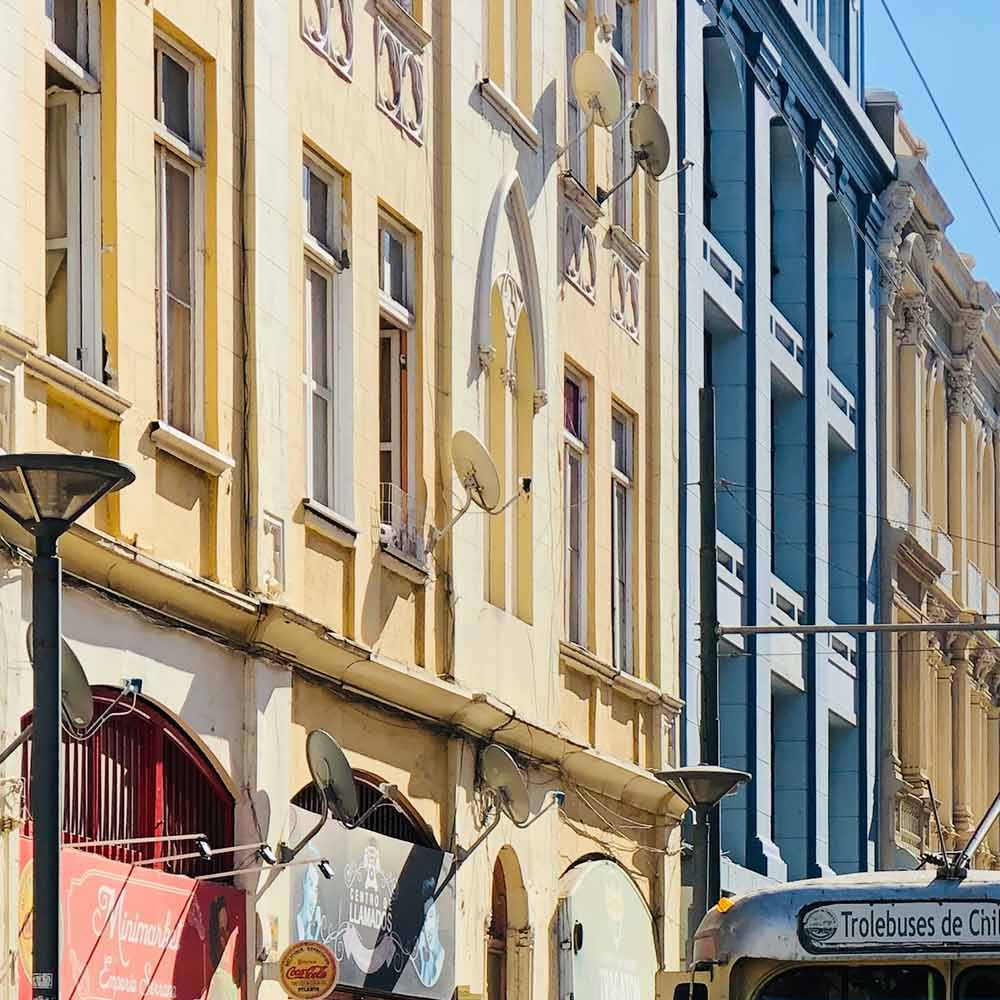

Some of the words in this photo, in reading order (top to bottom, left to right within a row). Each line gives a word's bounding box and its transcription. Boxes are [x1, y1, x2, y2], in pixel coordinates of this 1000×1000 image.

[350, 902, 392, 932] LLAMADOS
[841, 909, 935, 938] Trolebuses
[942, 912, 965, 937] de
